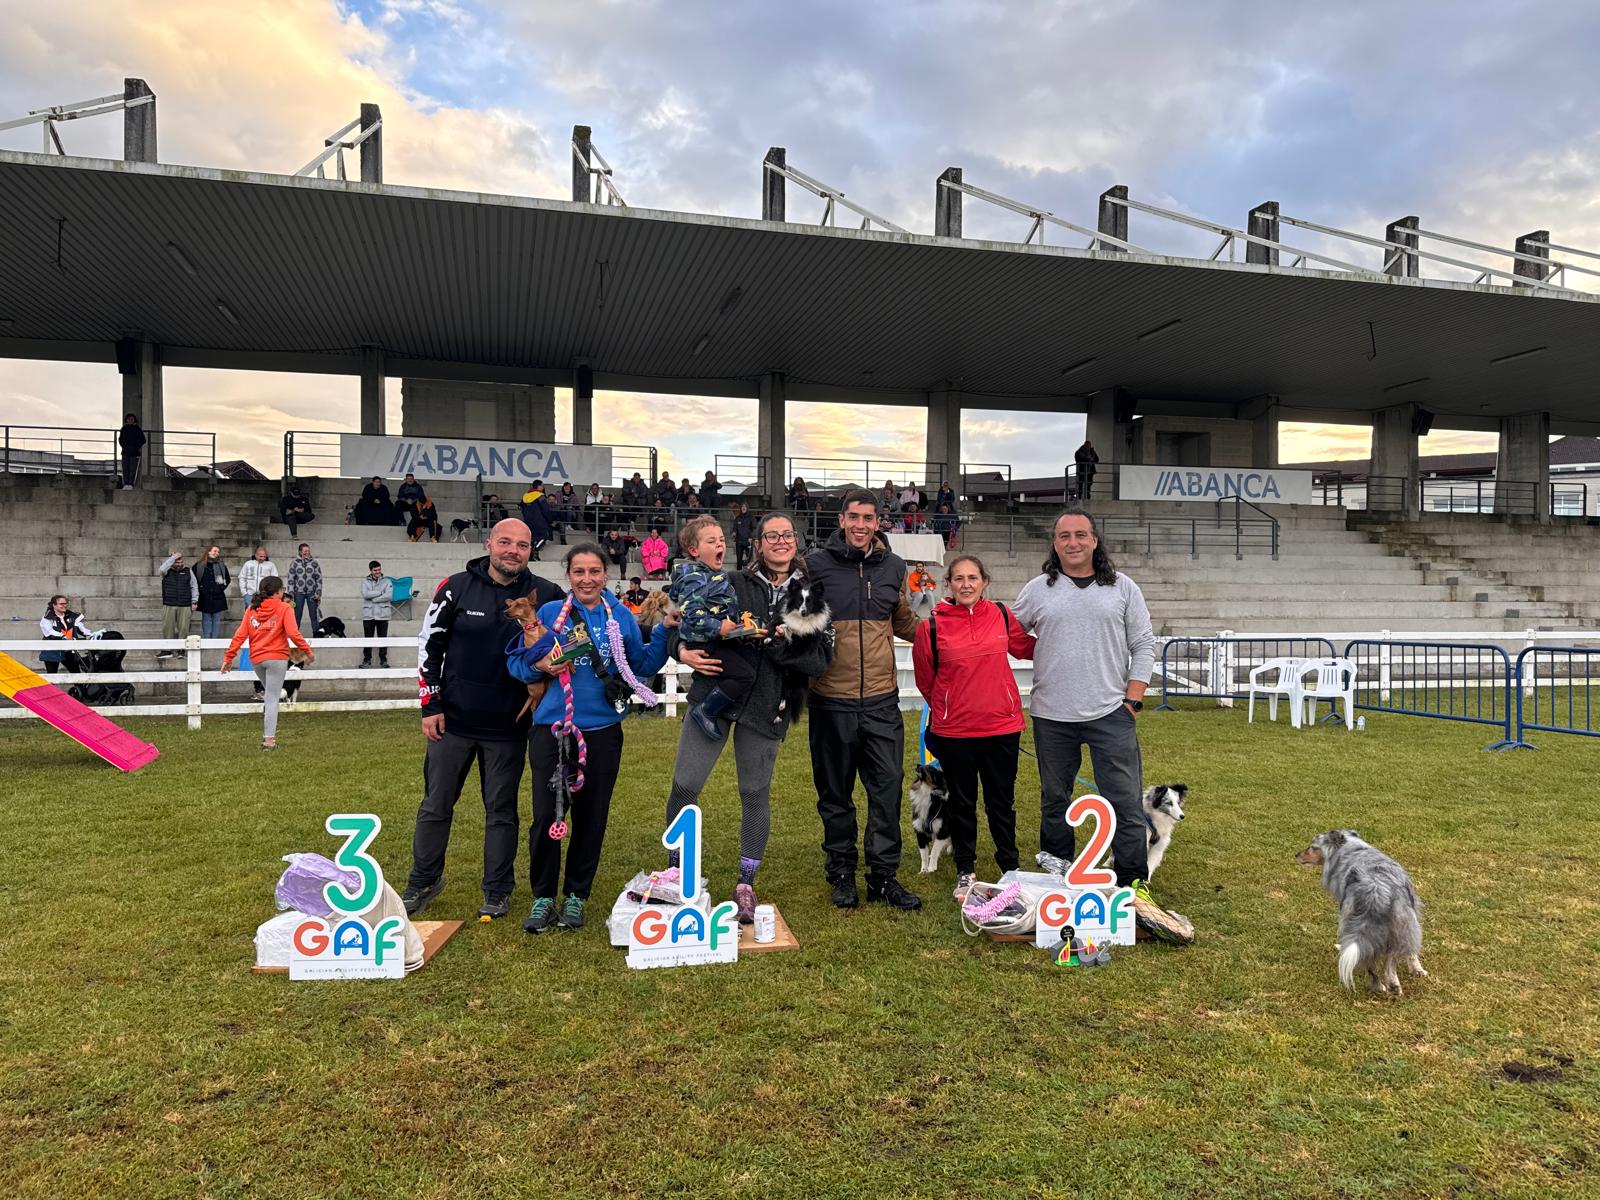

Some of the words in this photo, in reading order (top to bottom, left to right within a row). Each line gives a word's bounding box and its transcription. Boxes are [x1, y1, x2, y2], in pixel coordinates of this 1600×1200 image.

[327, 819, 378, 912] 3
[666, 808, 697, 899] 1
[1069, 799, 1112, 885] 2
